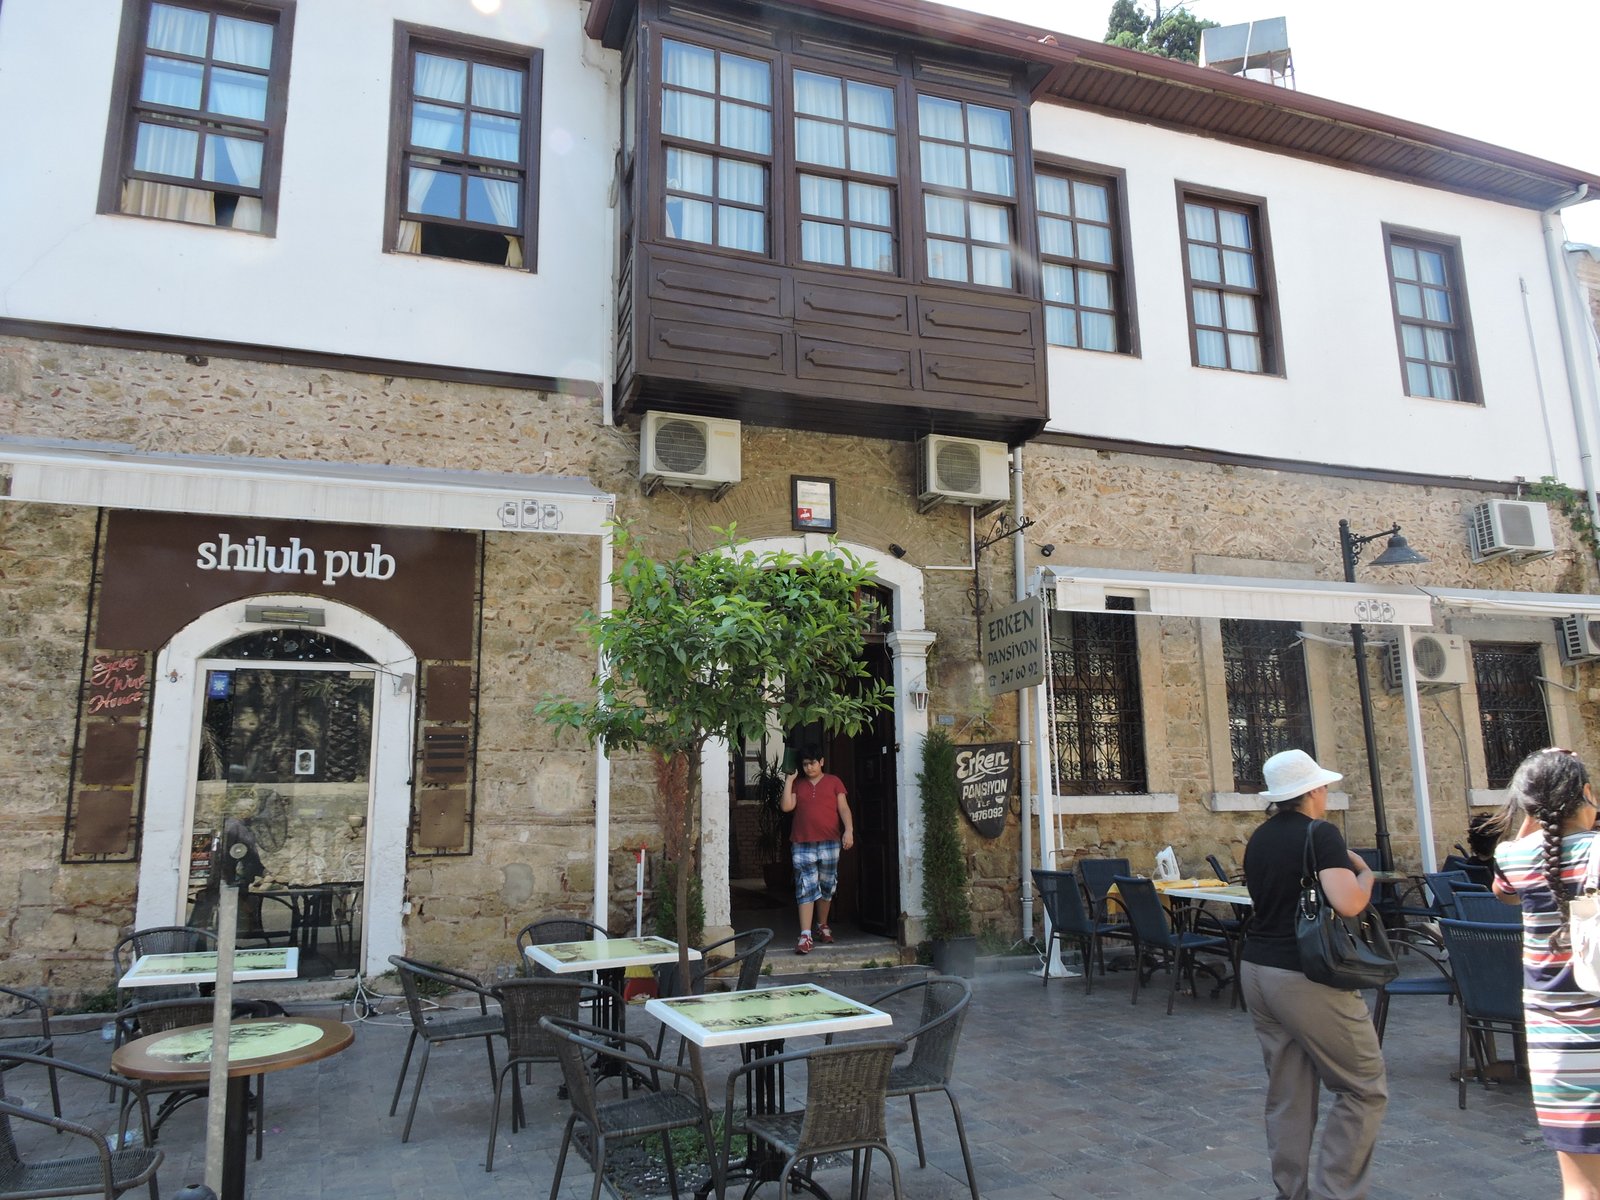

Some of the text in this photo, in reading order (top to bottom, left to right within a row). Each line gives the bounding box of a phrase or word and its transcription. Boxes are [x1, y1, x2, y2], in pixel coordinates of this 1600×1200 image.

[197, 533, 396, 586] shiluh pub
[988, 606, 1034, 642] ERKEN
[1001, 661, 1038, 684] 247 60 92
[88, 692, 143, 714] House
[956, 748, 1010, 784] Erken
